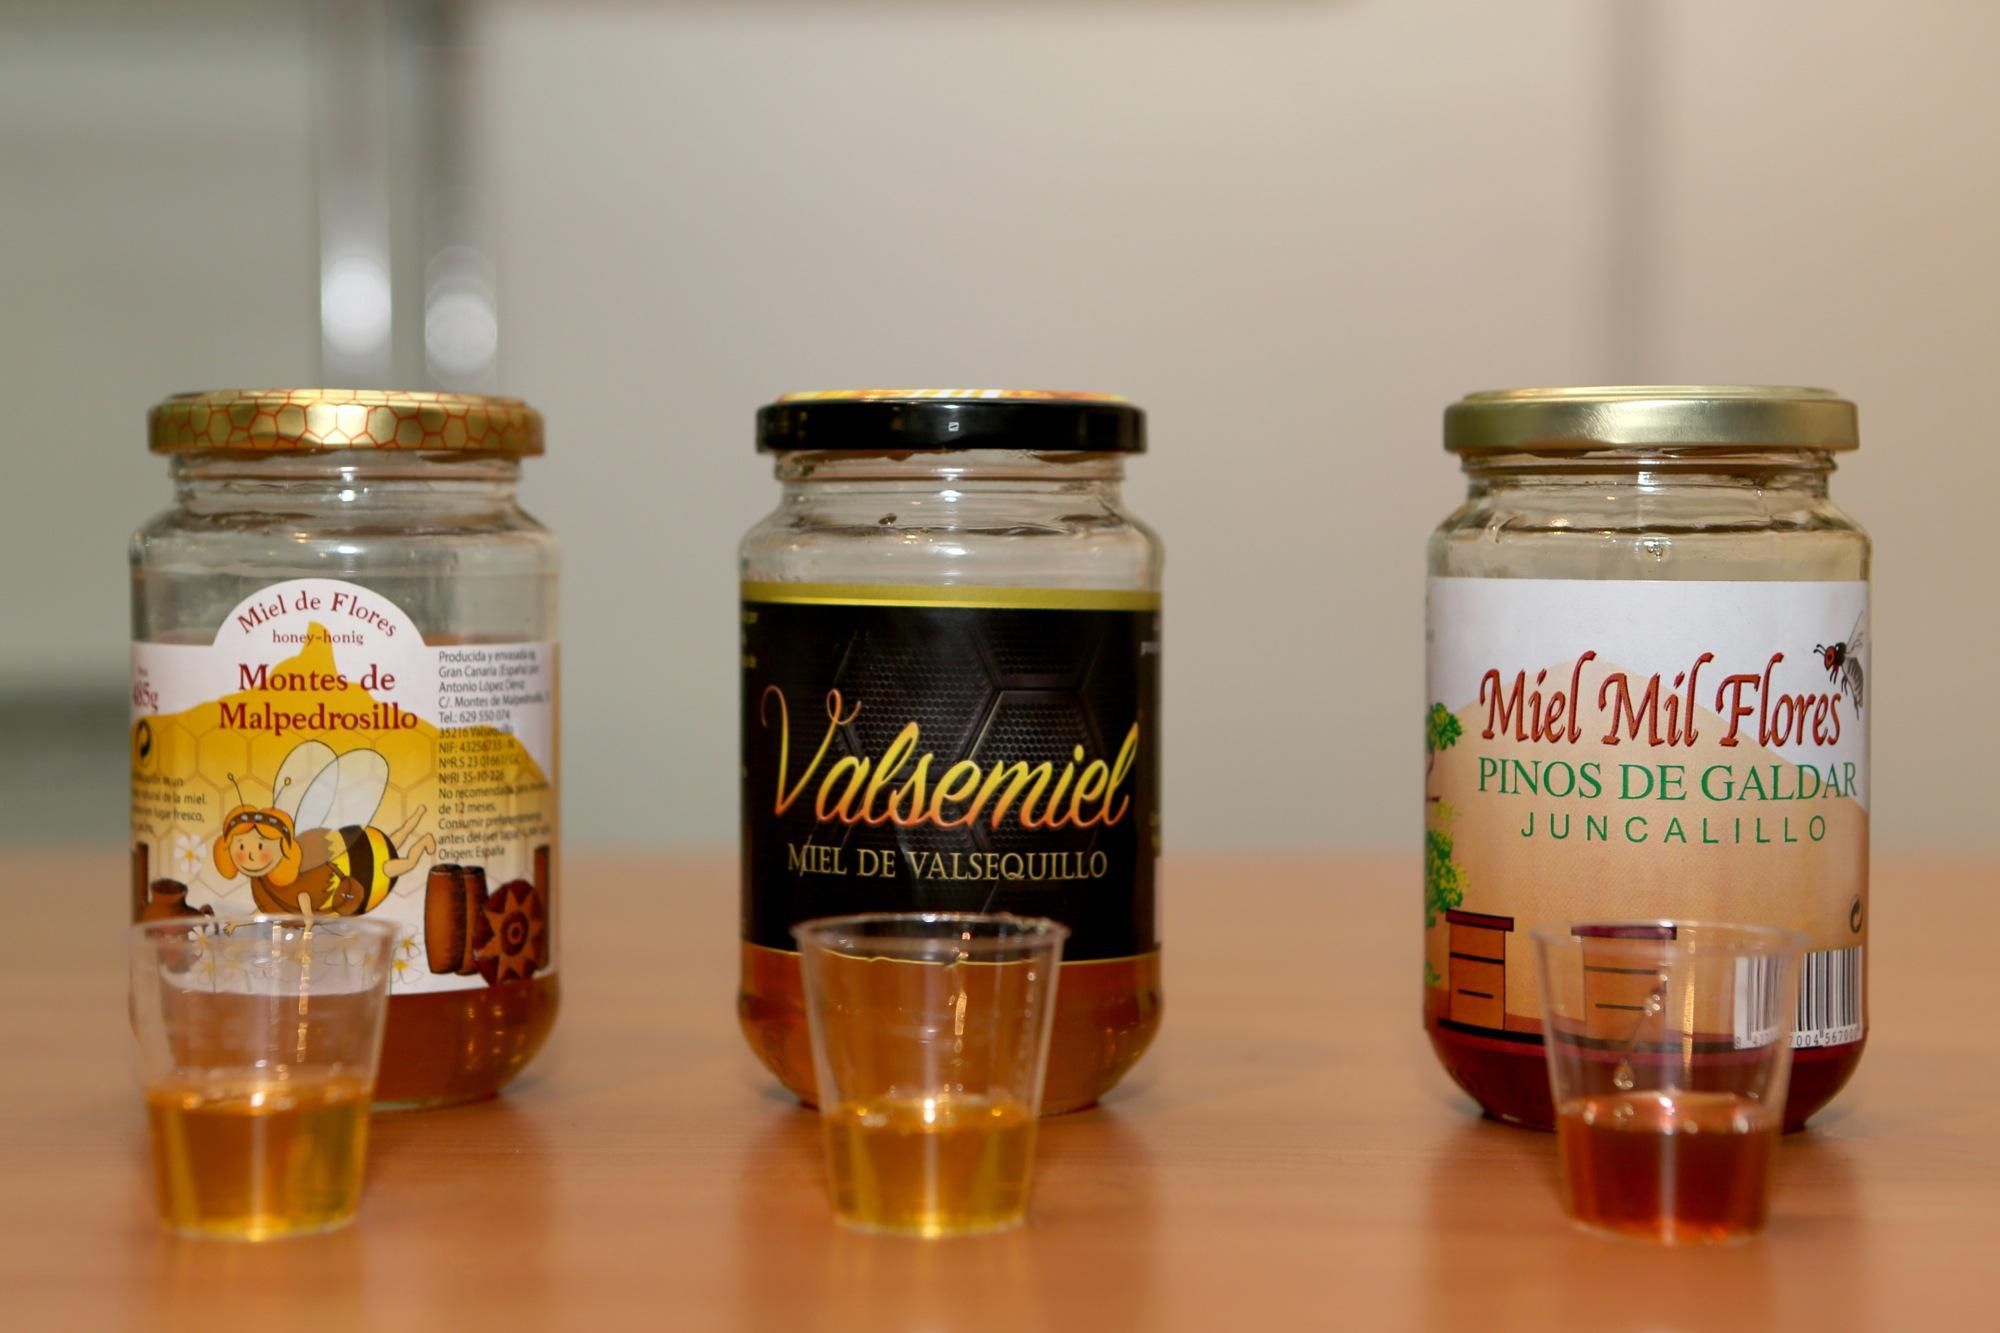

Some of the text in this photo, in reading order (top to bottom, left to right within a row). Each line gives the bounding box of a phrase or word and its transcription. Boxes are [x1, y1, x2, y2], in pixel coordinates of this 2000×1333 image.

[237, 590, 397, 637] Miel de Flores
[272, 629, 364, 646] honey-honig
[438, 649, 486, 662] Producida
[239, 663, 395, 691] Montes de
[438, 665, 462, 678] Gran
[464, 665, 497, 677] Canaria
[438, 681, 477, 693] Antonio
[479, 680, 503, 692] López
[455, 696, 488, 707] Montes
[491, 696, 500, 706] de
[1480, 650, 1842, 748] Miel Mil Flores
[219, 701, 418, 736] Malpedrosillo
[459, 711, 476, 722] 629
[761, 684, 1139, 829] Valsemiel
[1478, 756, 1857, 801] PINOS DE GALDAR
[439, 788, 453, 799] No
[173, 807, 205, 823] fresco,
[438, 803, 452, 814] de
[455, 802, 465, 814] 12
[1521, 811, 1826, 844] JUNCALILLO
[438, 833, 464, 845] antes
[788, 843, 1108, 880] MIEL DE VALSEQUILLO
